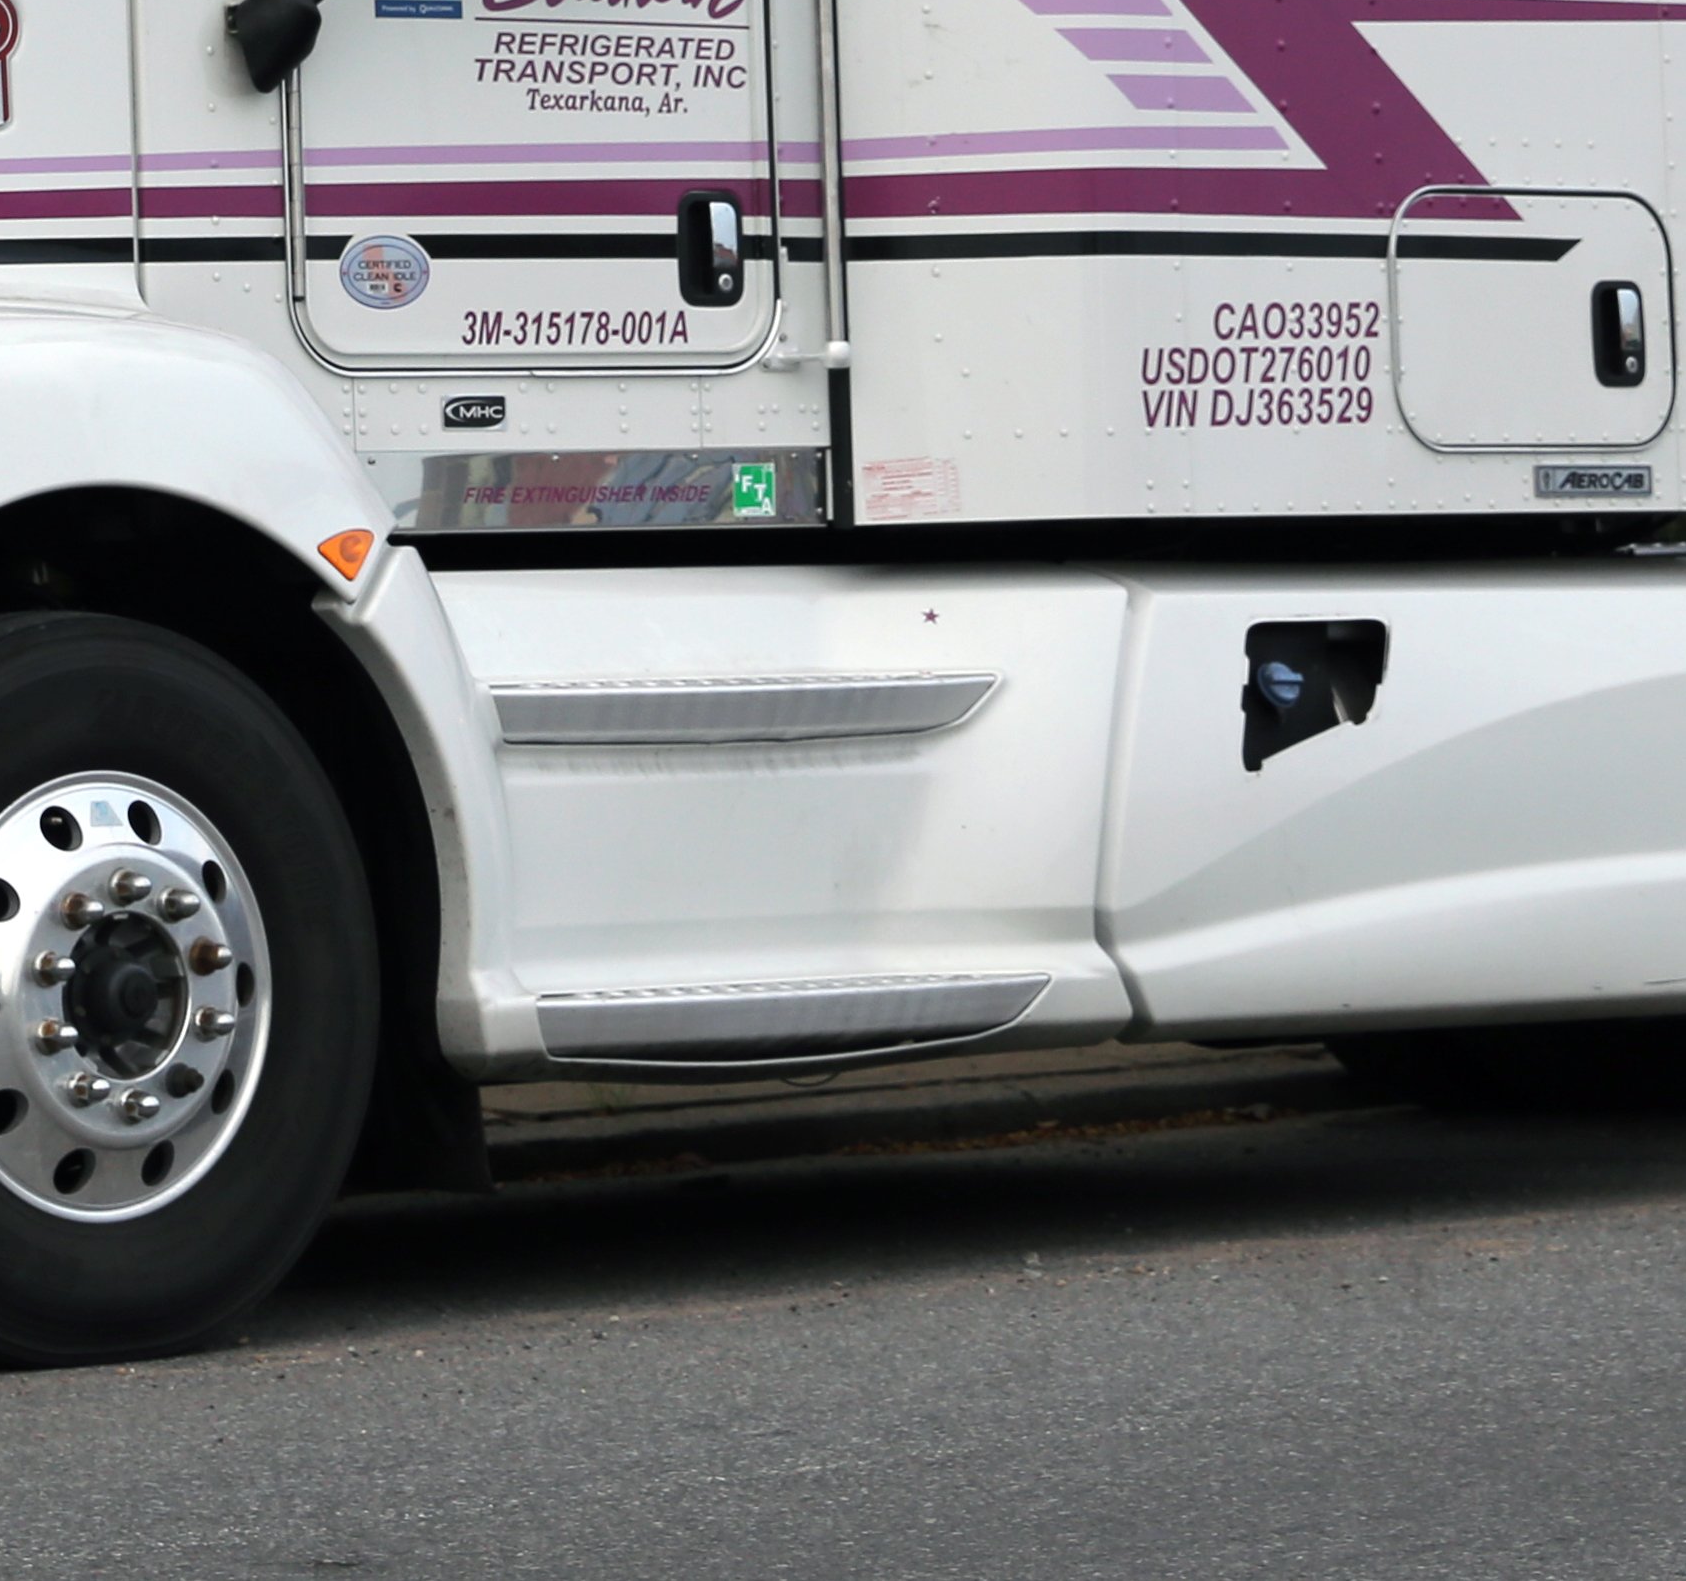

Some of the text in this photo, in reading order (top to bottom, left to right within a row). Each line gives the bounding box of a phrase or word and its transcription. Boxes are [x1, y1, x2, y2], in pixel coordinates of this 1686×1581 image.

[494, 32, 735, 61] REFRIGERATED
[475, 59, 748, 91] TRANSPORT, INC
[526, 88, 688, 117] Texarkana, Ar.
[353, 272, 415, 281] CLEAN IDLE
[358, 260, 411, 269] CERTIFIED
[462, 310, 689, 346] 3M-315178-001A
[1141, 345, 1371, 384] USDOT276010
[459, 405, 504, 419] MHC
[1142, 386, 1373, 428] VIN DJ363529
[464, 485, 711, 504] FIRE EXTINGUISHER INSIDE
[1559, 471, 1644, 490] AEROCAB
